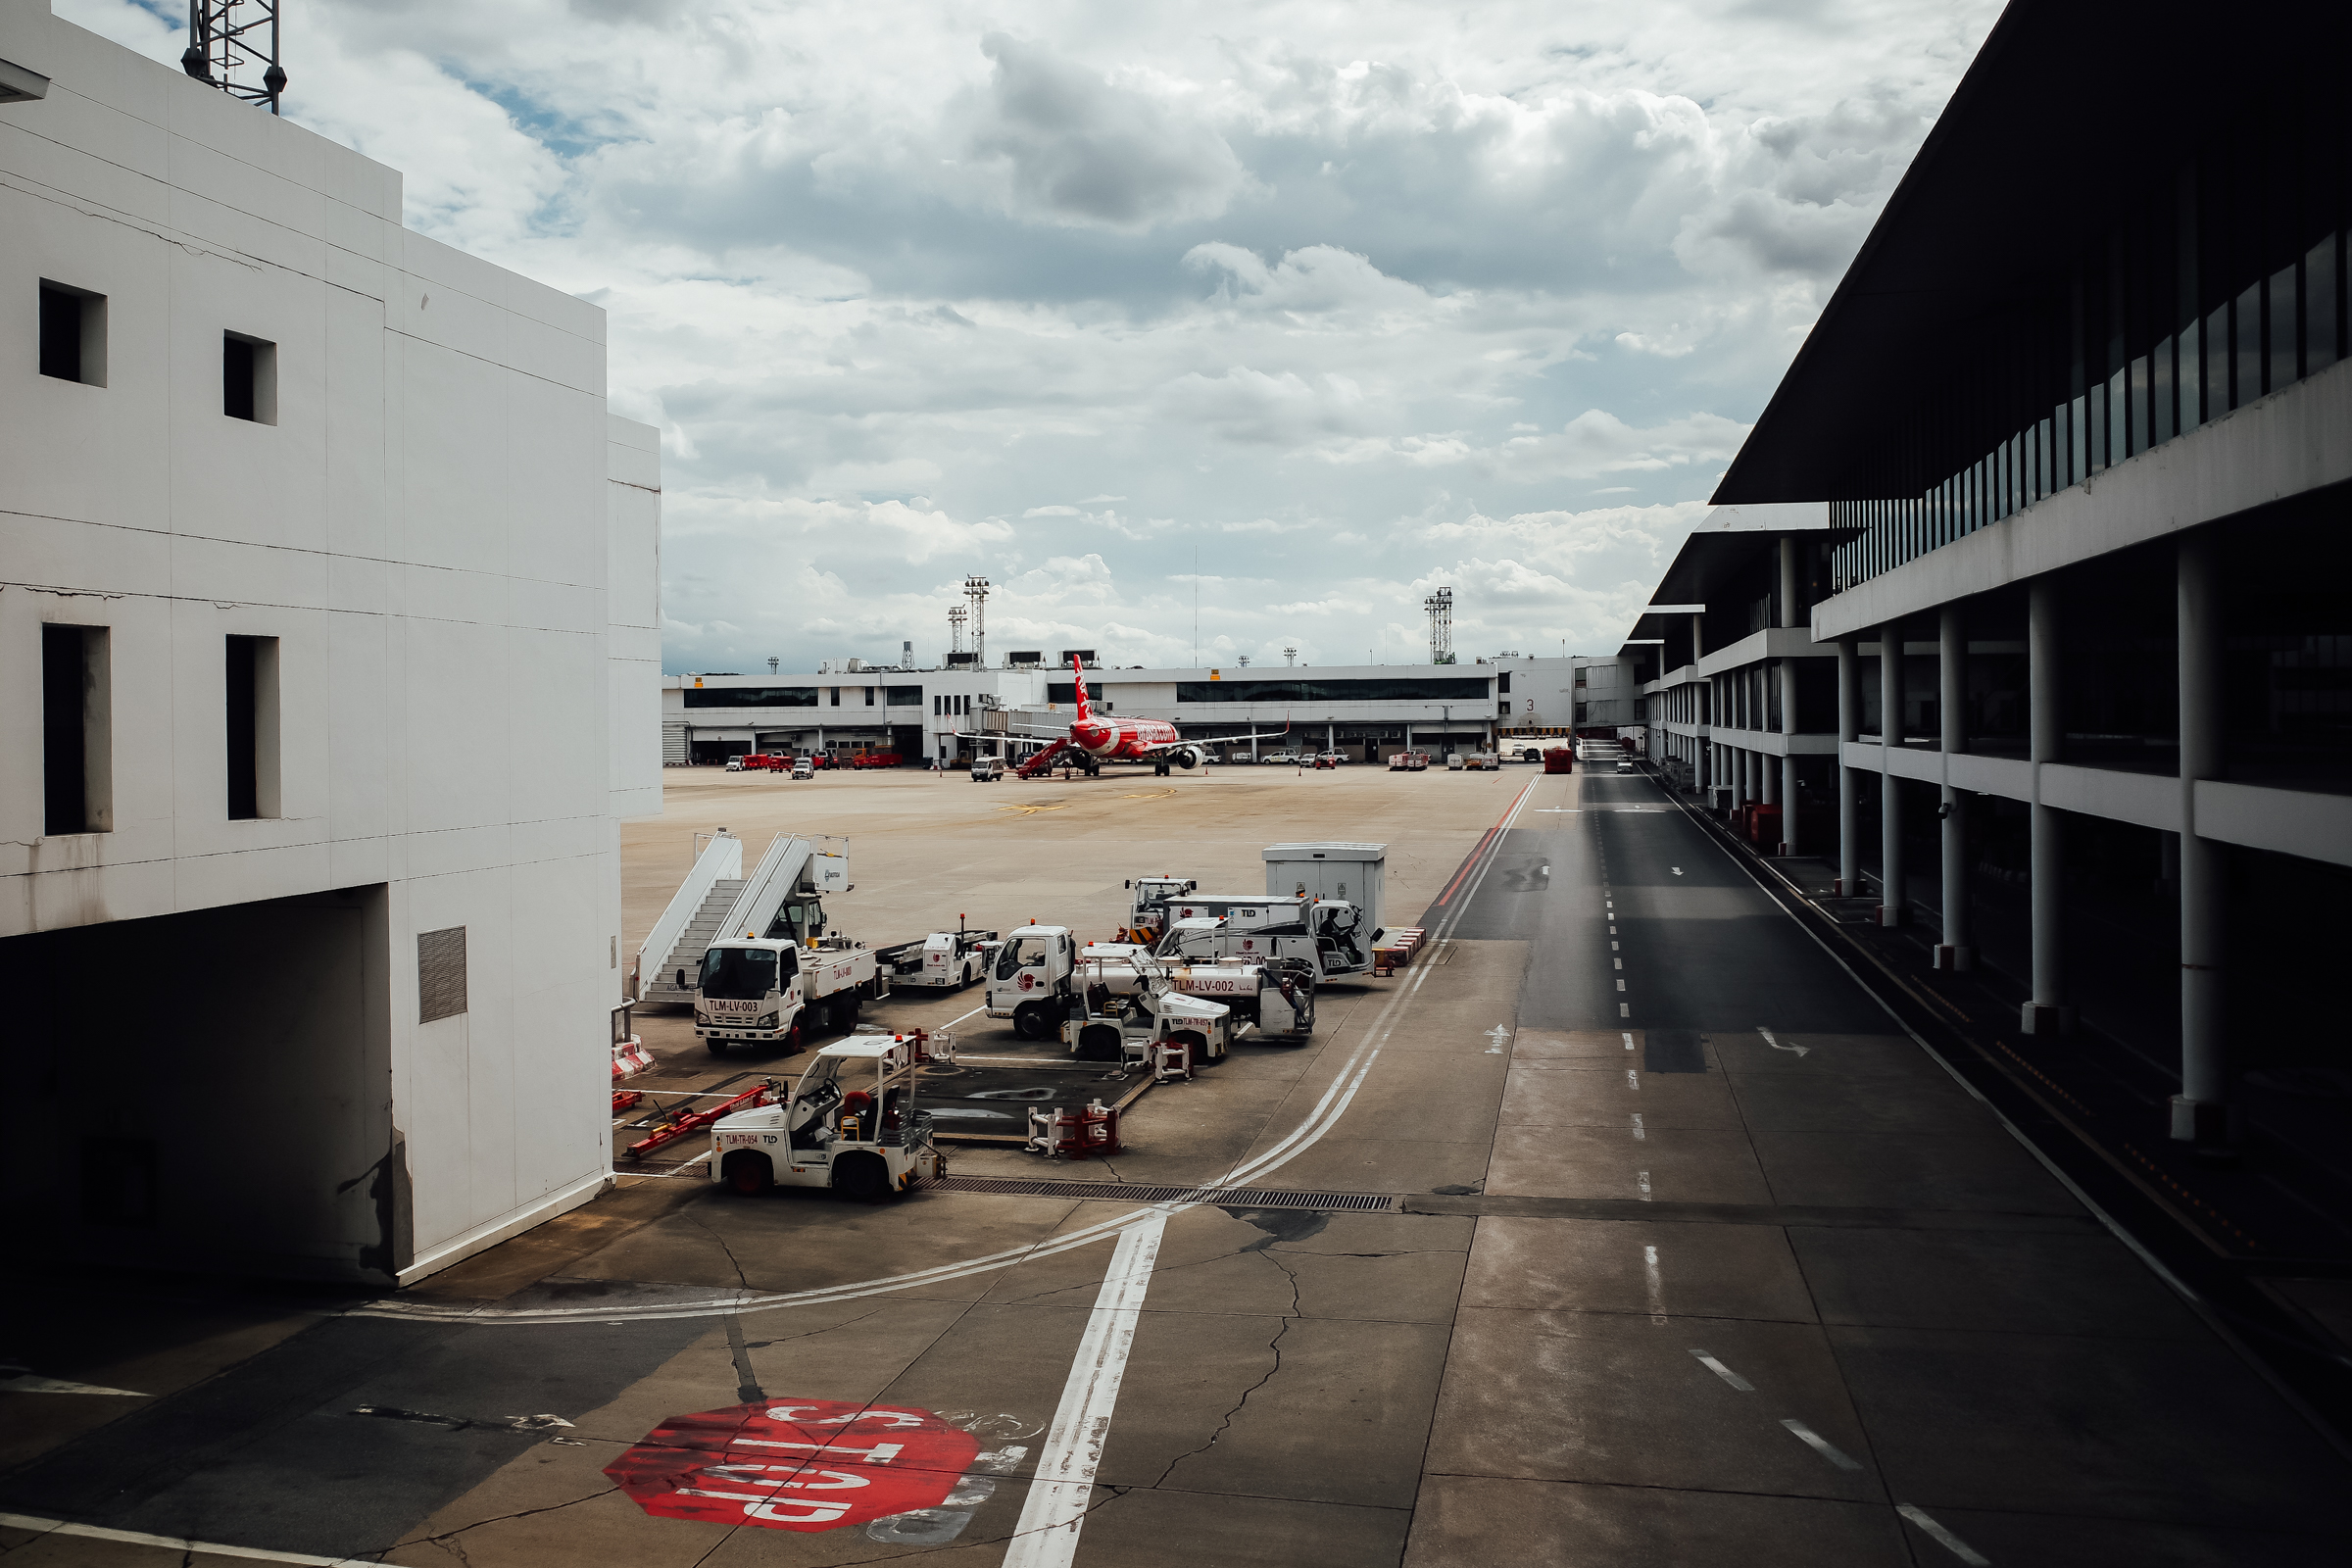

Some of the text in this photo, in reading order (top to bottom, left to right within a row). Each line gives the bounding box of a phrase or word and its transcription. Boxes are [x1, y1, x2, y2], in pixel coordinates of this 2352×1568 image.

[1526, 699, 1535, 711] 3
[1242, 908, 1256, 917] TLD
[1172, 980, 1234, 992] TLM-LV-002
[709, 1000, 758, 1012] TLM-LV-003
[726, 1134, 778, 1145] TLM-TR-054 TLD
[676, 1405, 924, 1523] STOP
